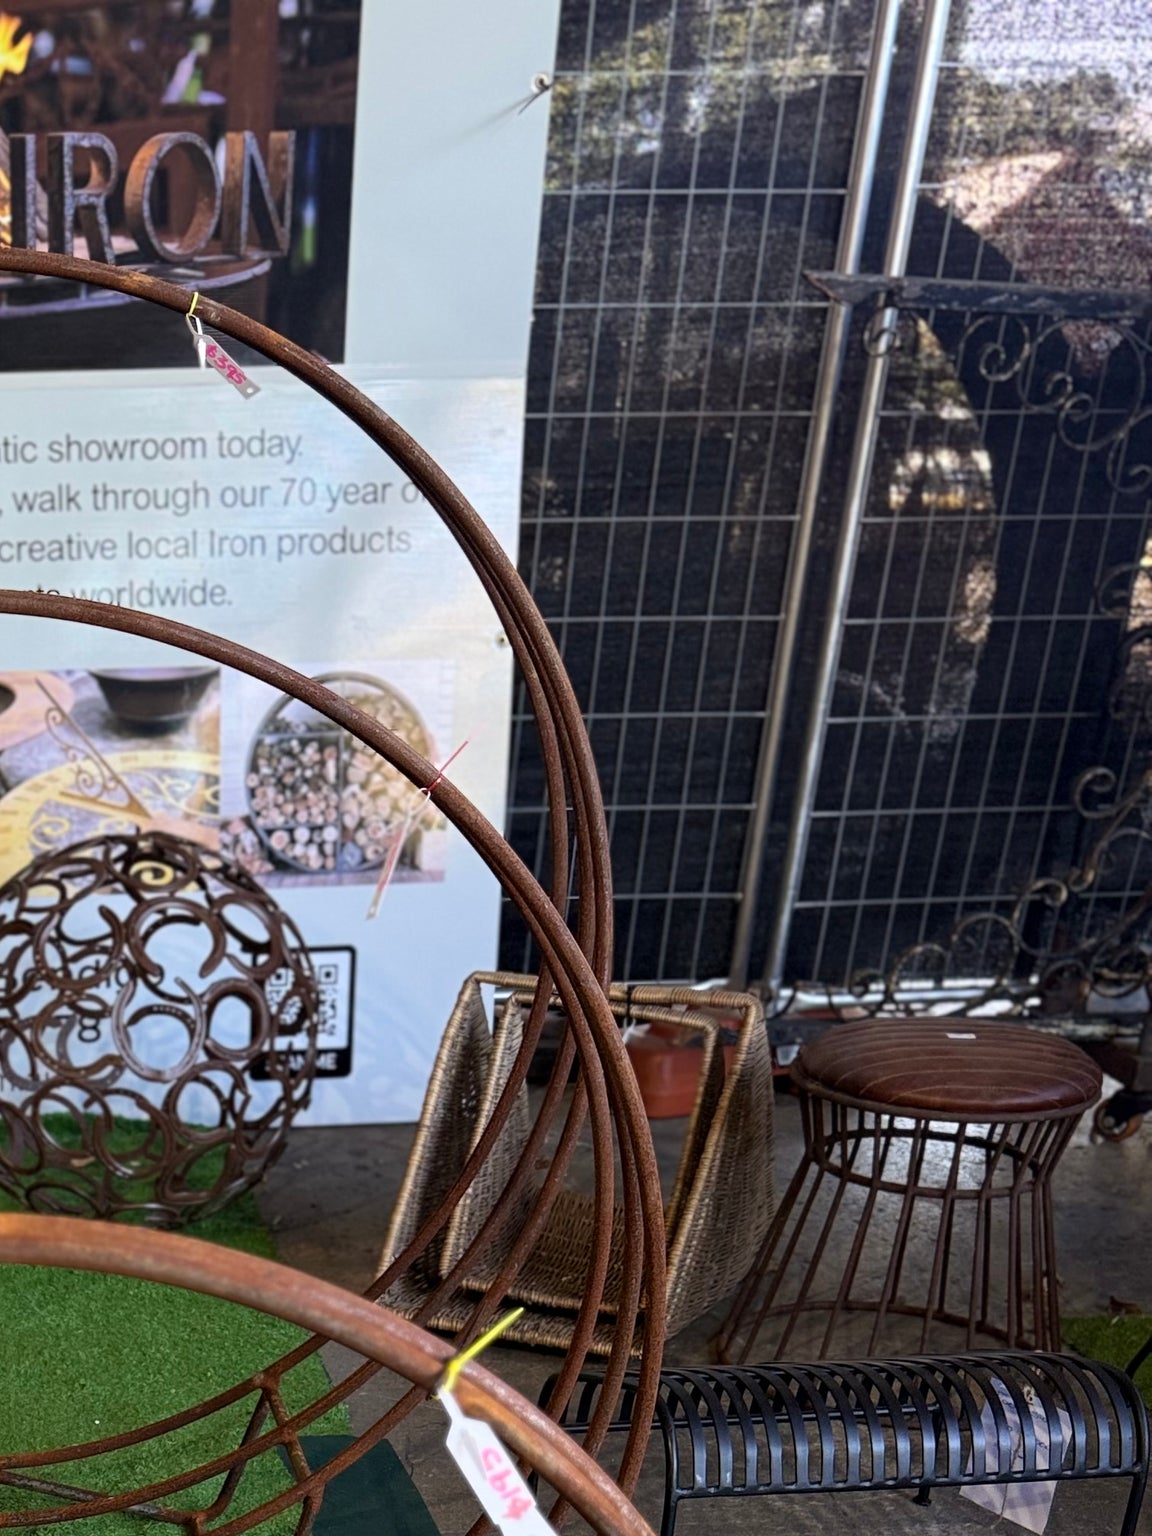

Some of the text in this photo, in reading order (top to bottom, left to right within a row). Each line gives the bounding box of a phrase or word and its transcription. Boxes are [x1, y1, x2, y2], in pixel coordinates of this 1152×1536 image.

[48, 433, 207, 462] showroom
[217, 429, 303, 467] today.
[14, 483, 82, 513] walk
[92, 481, 212, 517] through
[221, 483, 271, 509] our
[281, 478, 317, 508] 70
[325, 480, 392, 514] year
[401, 480, 429, 503] o
[128, 530, 198, 559] local
[209, 529, 267, 557] Iron
[277, 525, 412, 562] products
